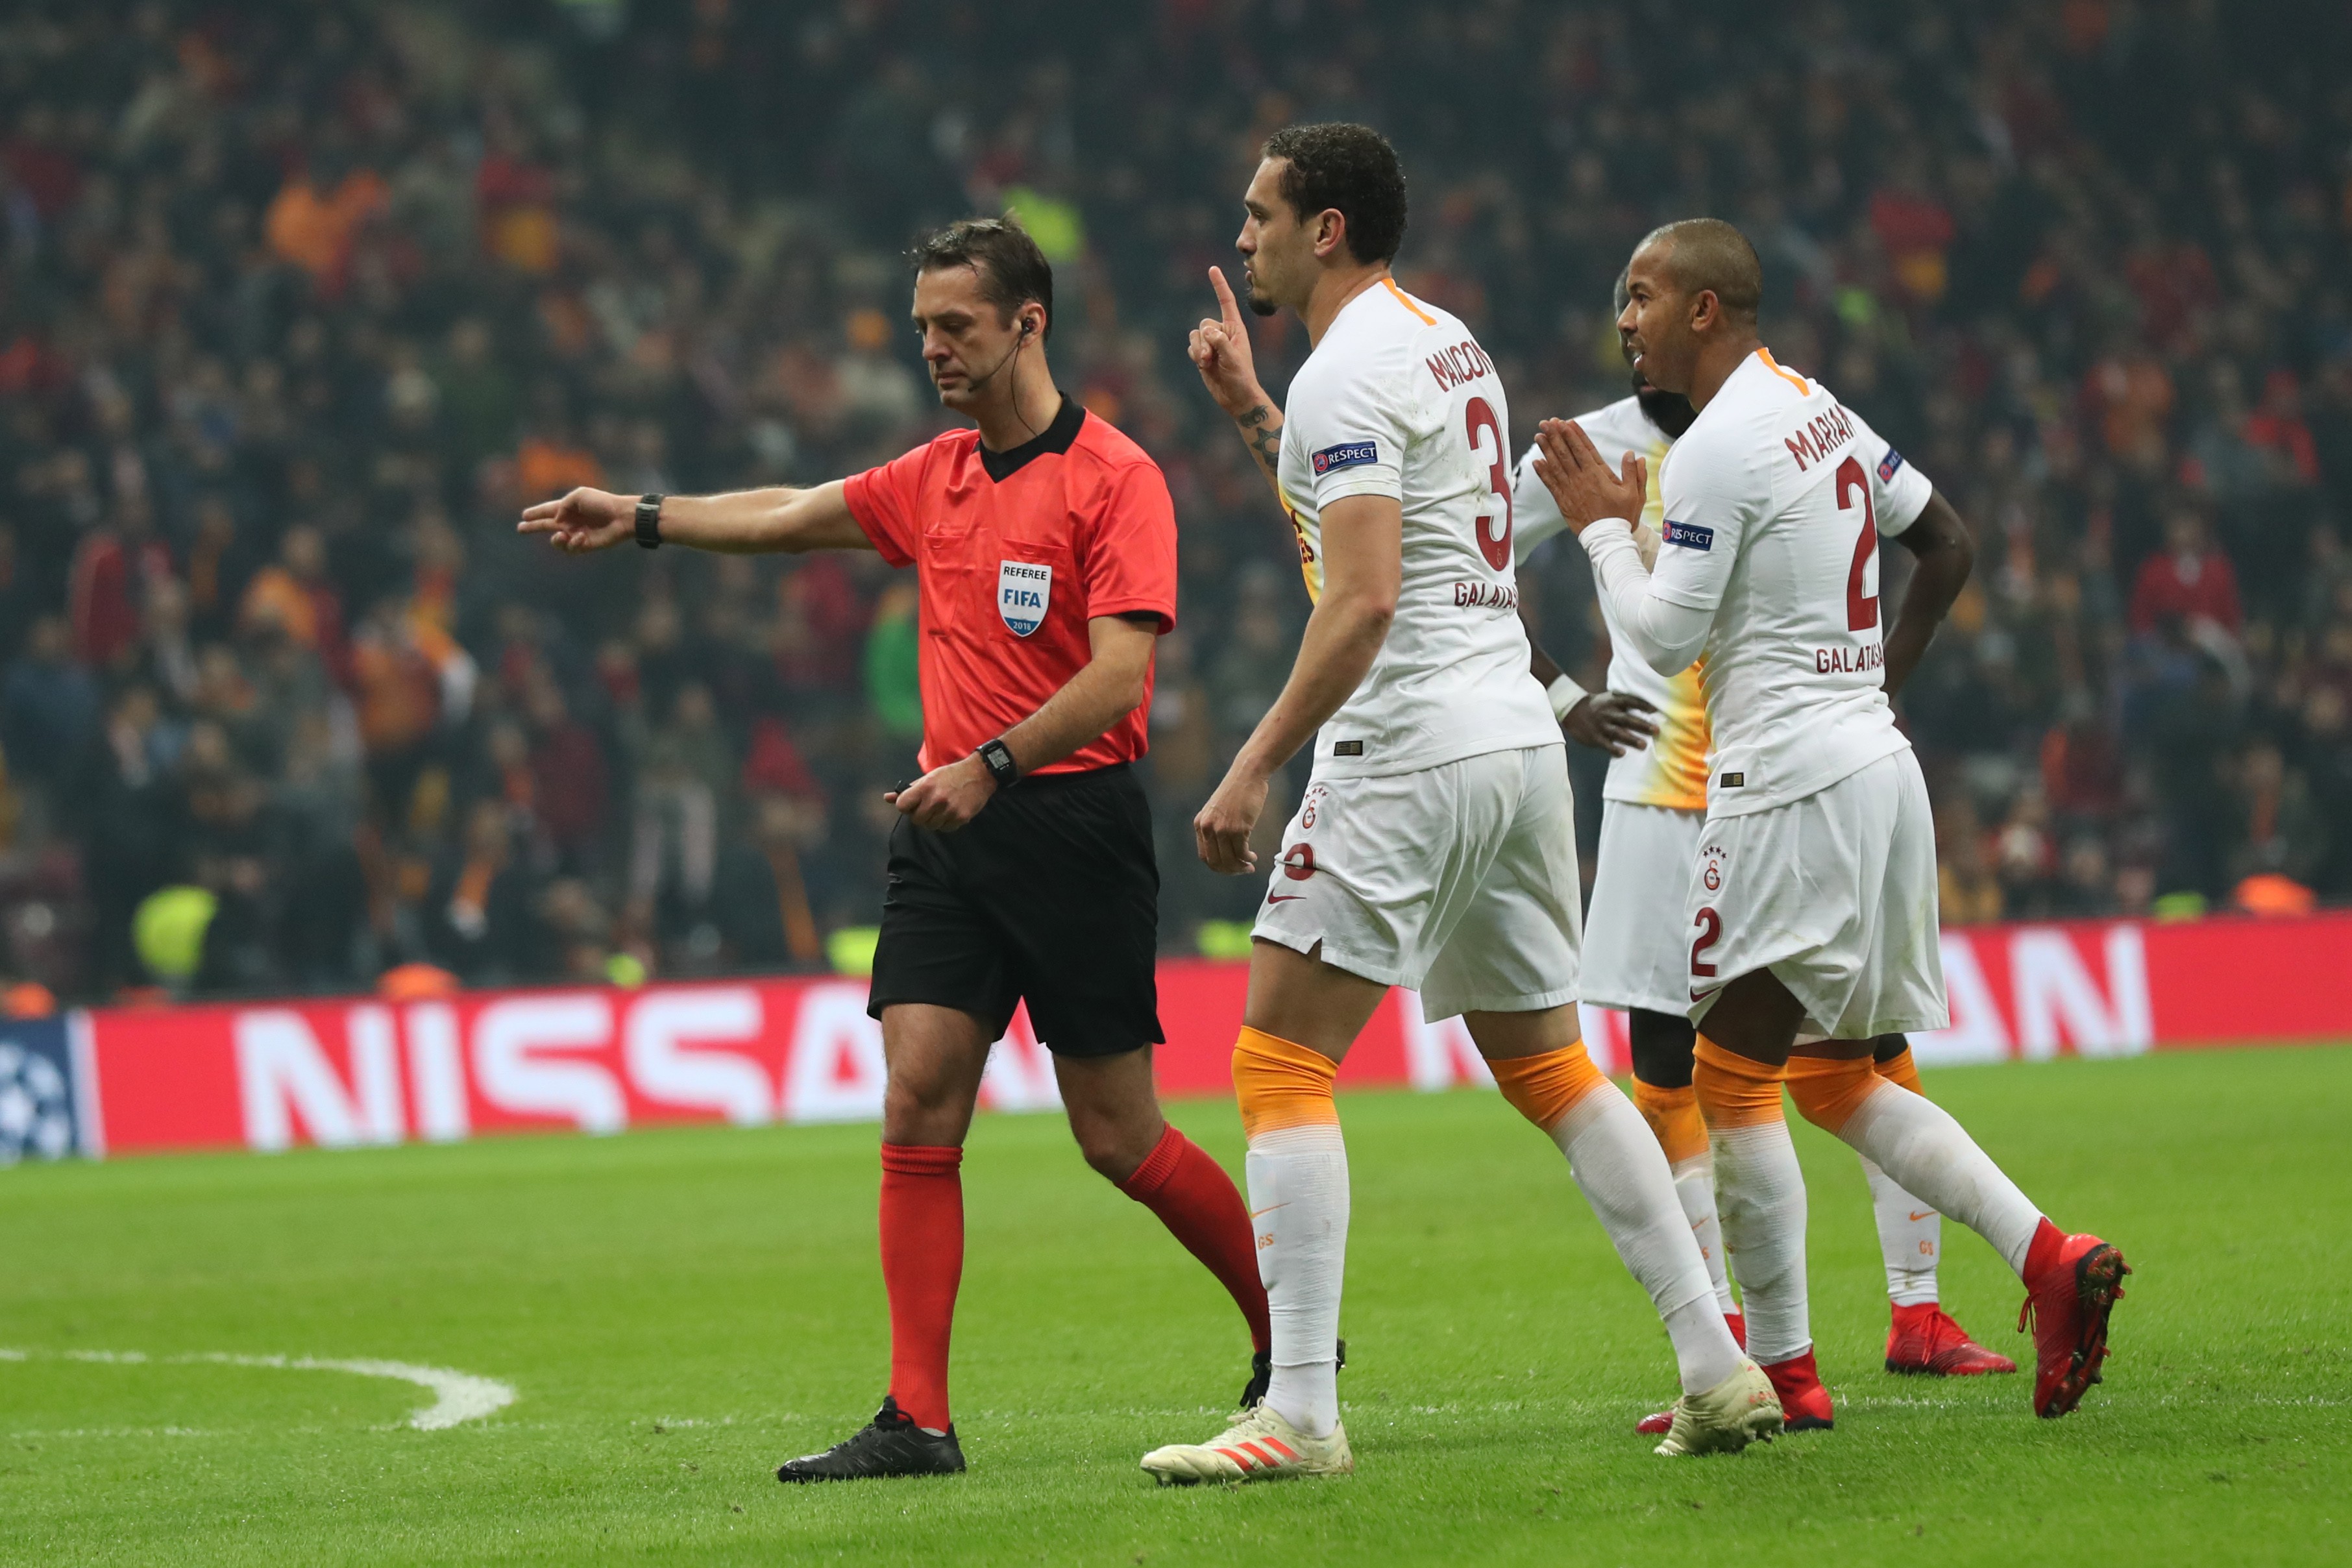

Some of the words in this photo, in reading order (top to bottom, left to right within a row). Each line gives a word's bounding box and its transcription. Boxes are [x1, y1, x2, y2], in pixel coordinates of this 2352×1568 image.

[1426, 339, 1495, 392] MAICON
[1328, 447, 1375, 464] RESPECT
[1465, 397, 1512, 571] 3
[1836, 455, 1879, 631] 2
[1004, 567, 1047, 580] REFEREE
[1004, 589, 1041, 608] FIFA
[1013, 621, 1031, 630] 2018
[1691, 907, 1722, 977] 2
